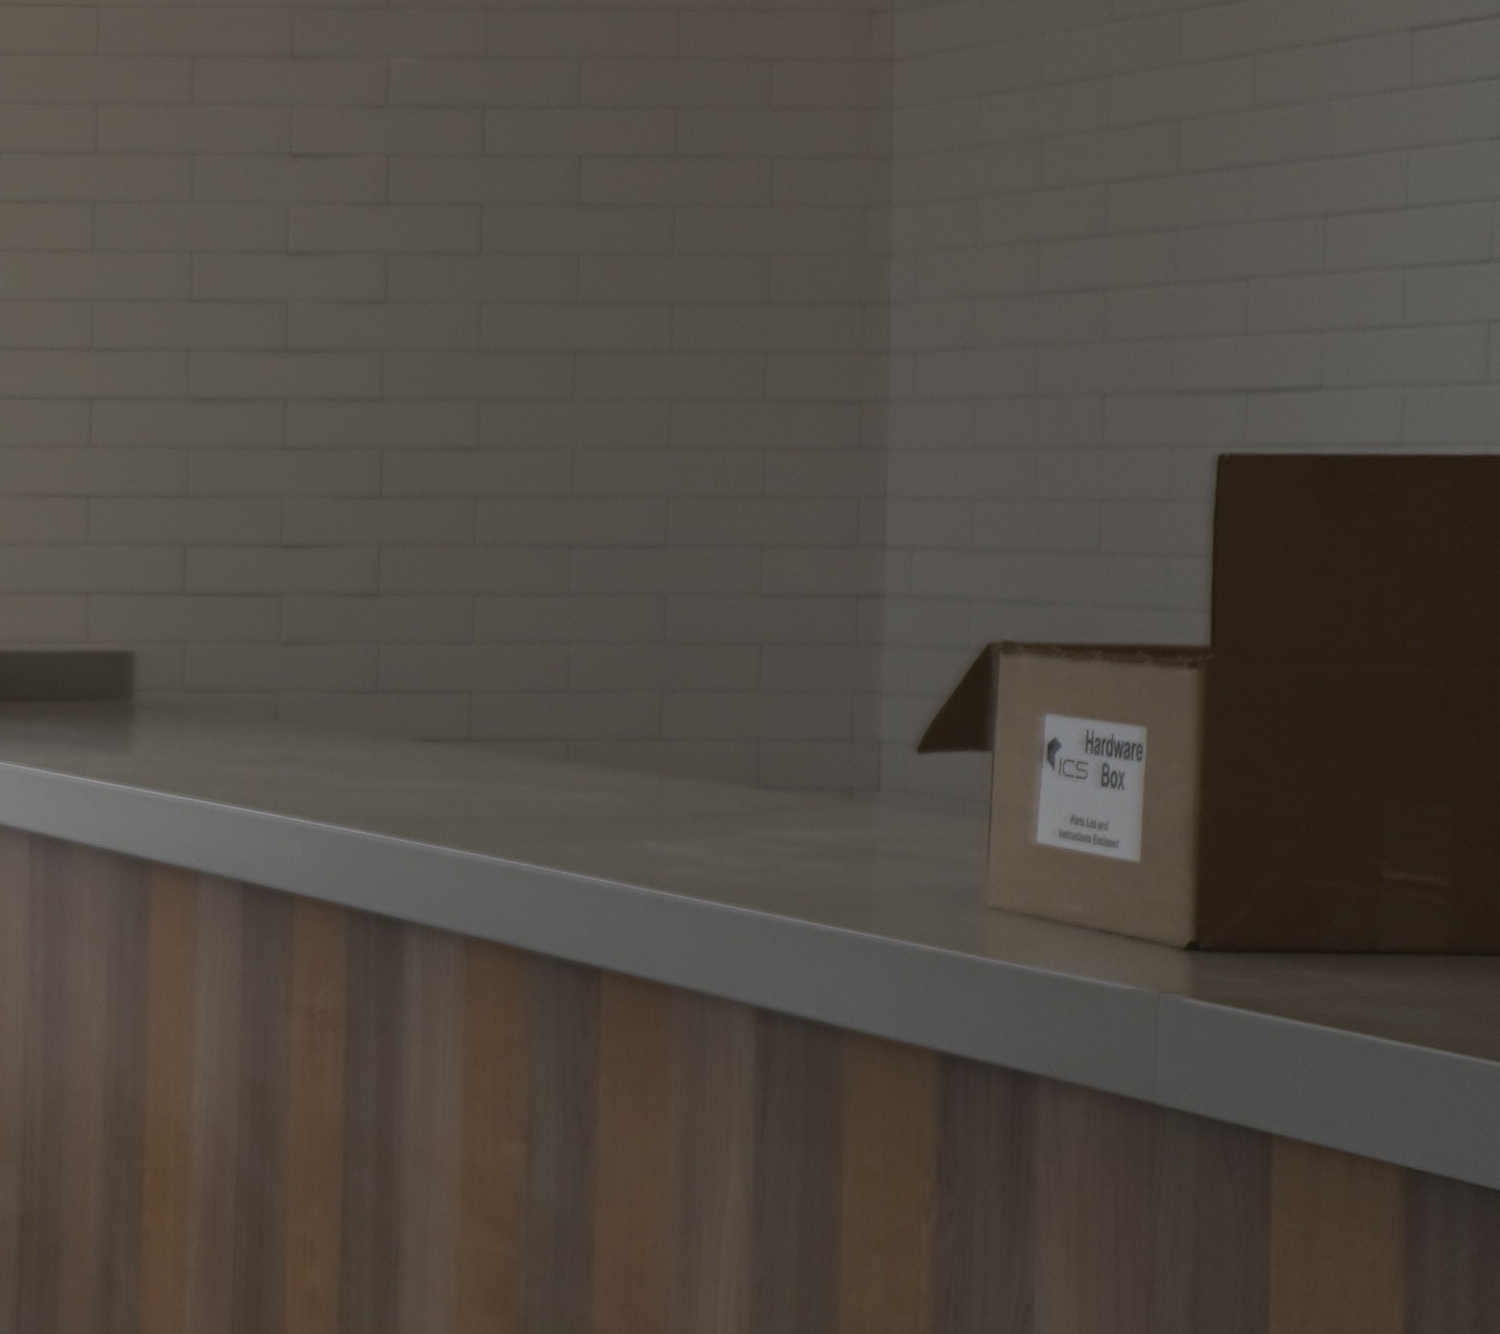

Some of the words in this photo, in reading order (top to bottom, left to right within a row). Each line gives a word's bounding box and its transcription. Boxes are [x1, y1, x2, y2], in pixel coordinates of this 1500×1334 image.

[1085, 729, 1143, 762] Hardware
[1058, 757, 1089, 781] ICS
[1101, 762, 1125, 790] Box
